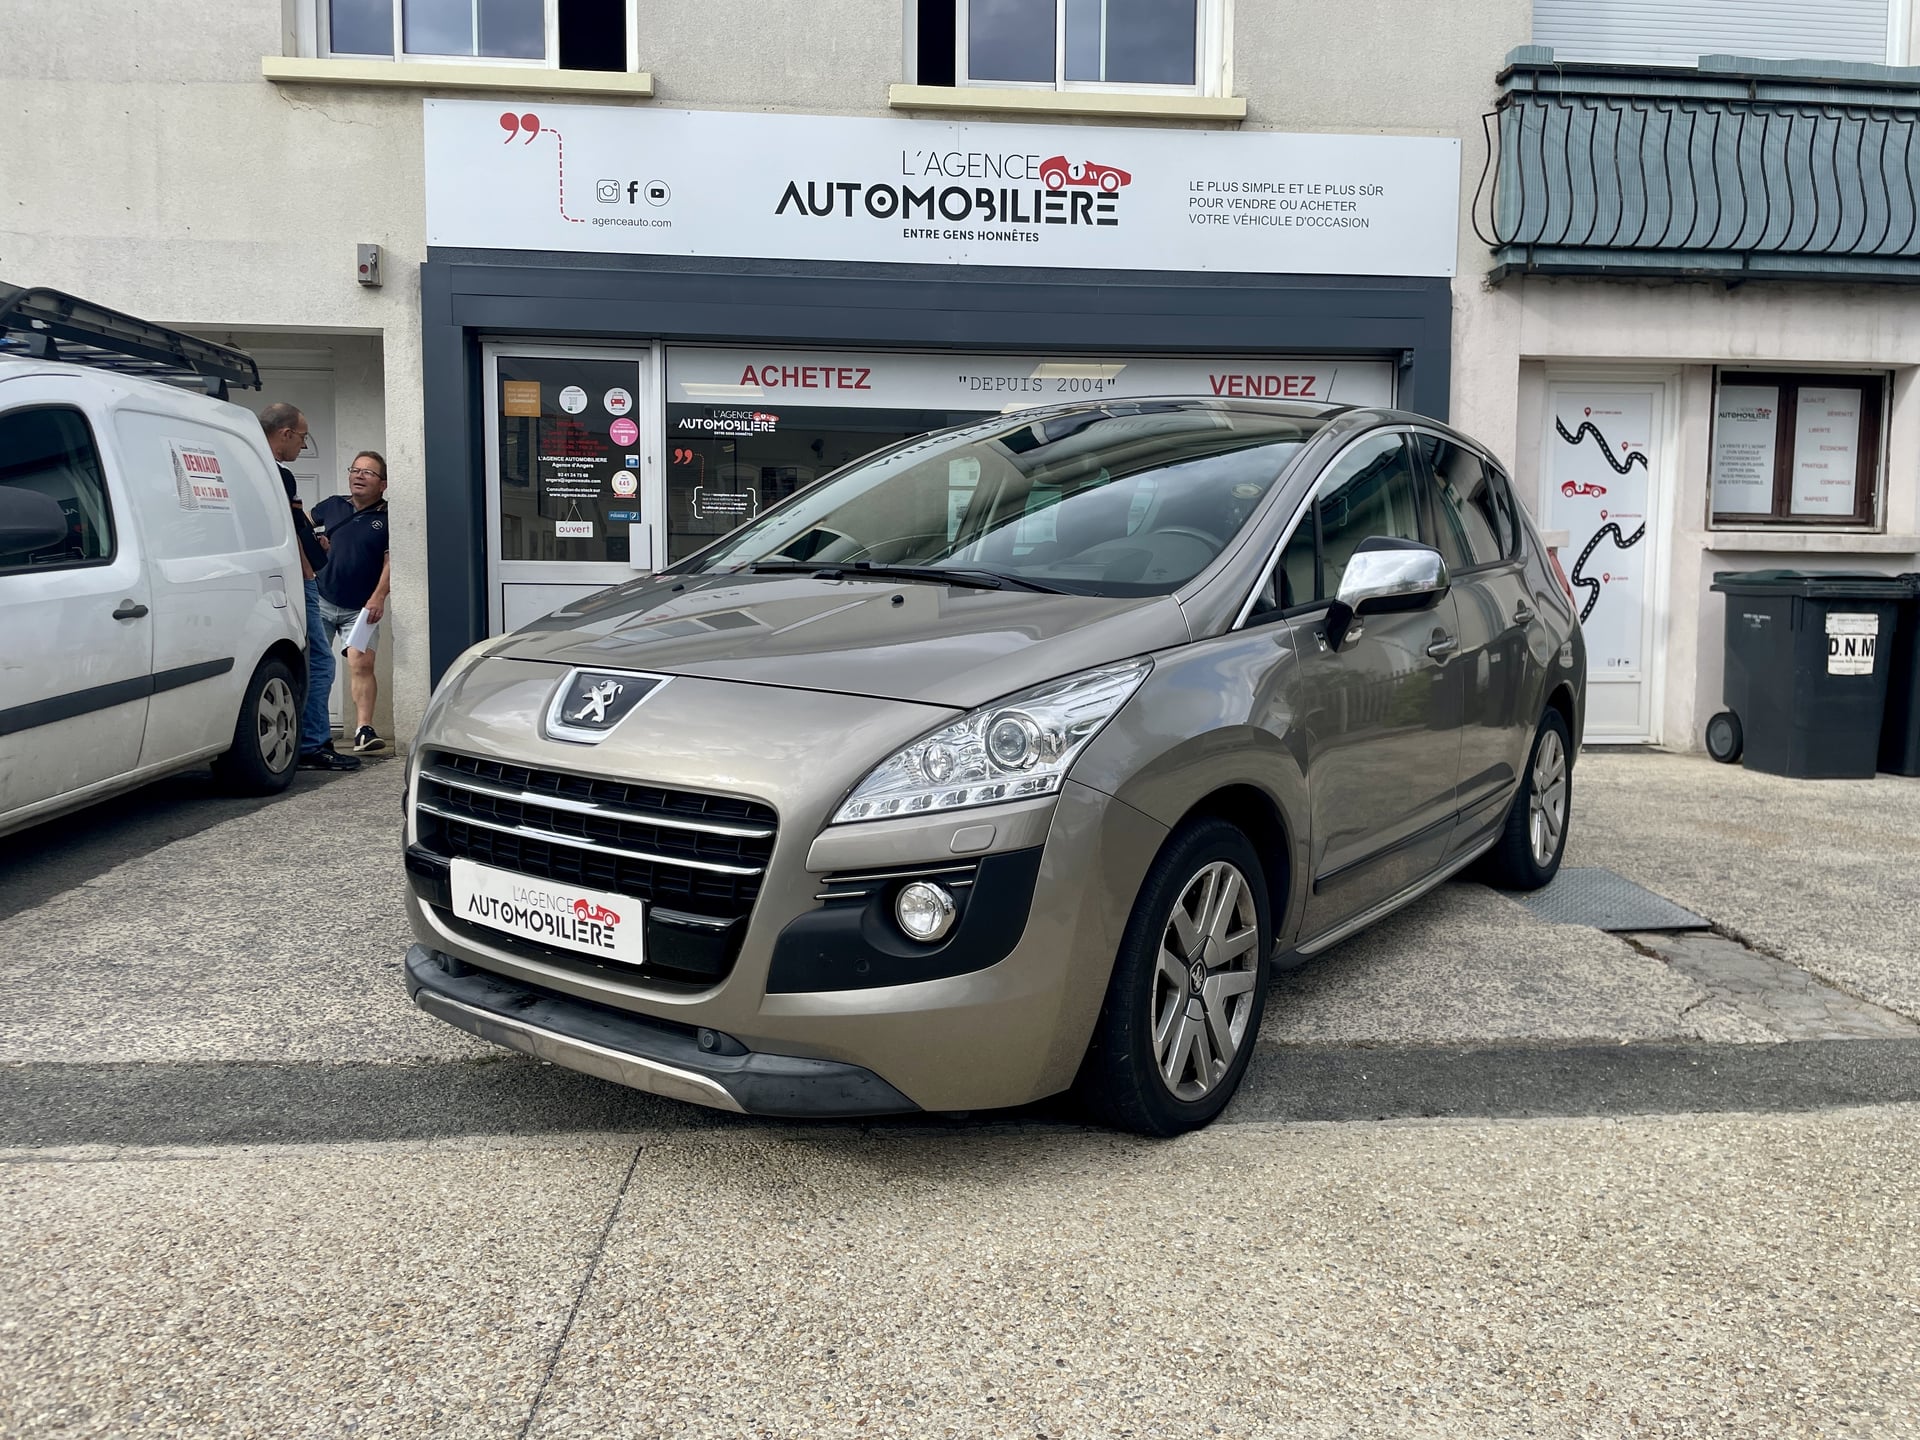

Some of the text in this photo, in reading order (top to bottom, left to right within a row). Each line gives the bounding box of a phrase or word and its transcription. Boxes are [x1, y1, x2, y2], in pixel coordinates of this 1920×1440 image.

[902, 149, 1041, 181] L'AGENCE
[1189, 181, 1384, 196] LE PLUS SIMPLE ET LE PLUS SÛR
[1189, 197, 1357, 212] POUR VENDRE OU ACHETER
[591, 217, 672, 228] agenceauto.com
[1188, 212, 1369, 228] VOTRE VÉHICULE D'OCCASION
[903, 228, 1040, 242] ENTRE GENS HONNÊTES
[739, 365, 872, 390] ACHETEZ
[1208, 374, 1317, 397] VENDEZ
[713, 409, 754, 420] L'AGENCE
[183, 453, 221, 474] DENIAUD
[558, 524, 590, 534] ouvert
[512, 885, 575, 915] L'AGENCE
